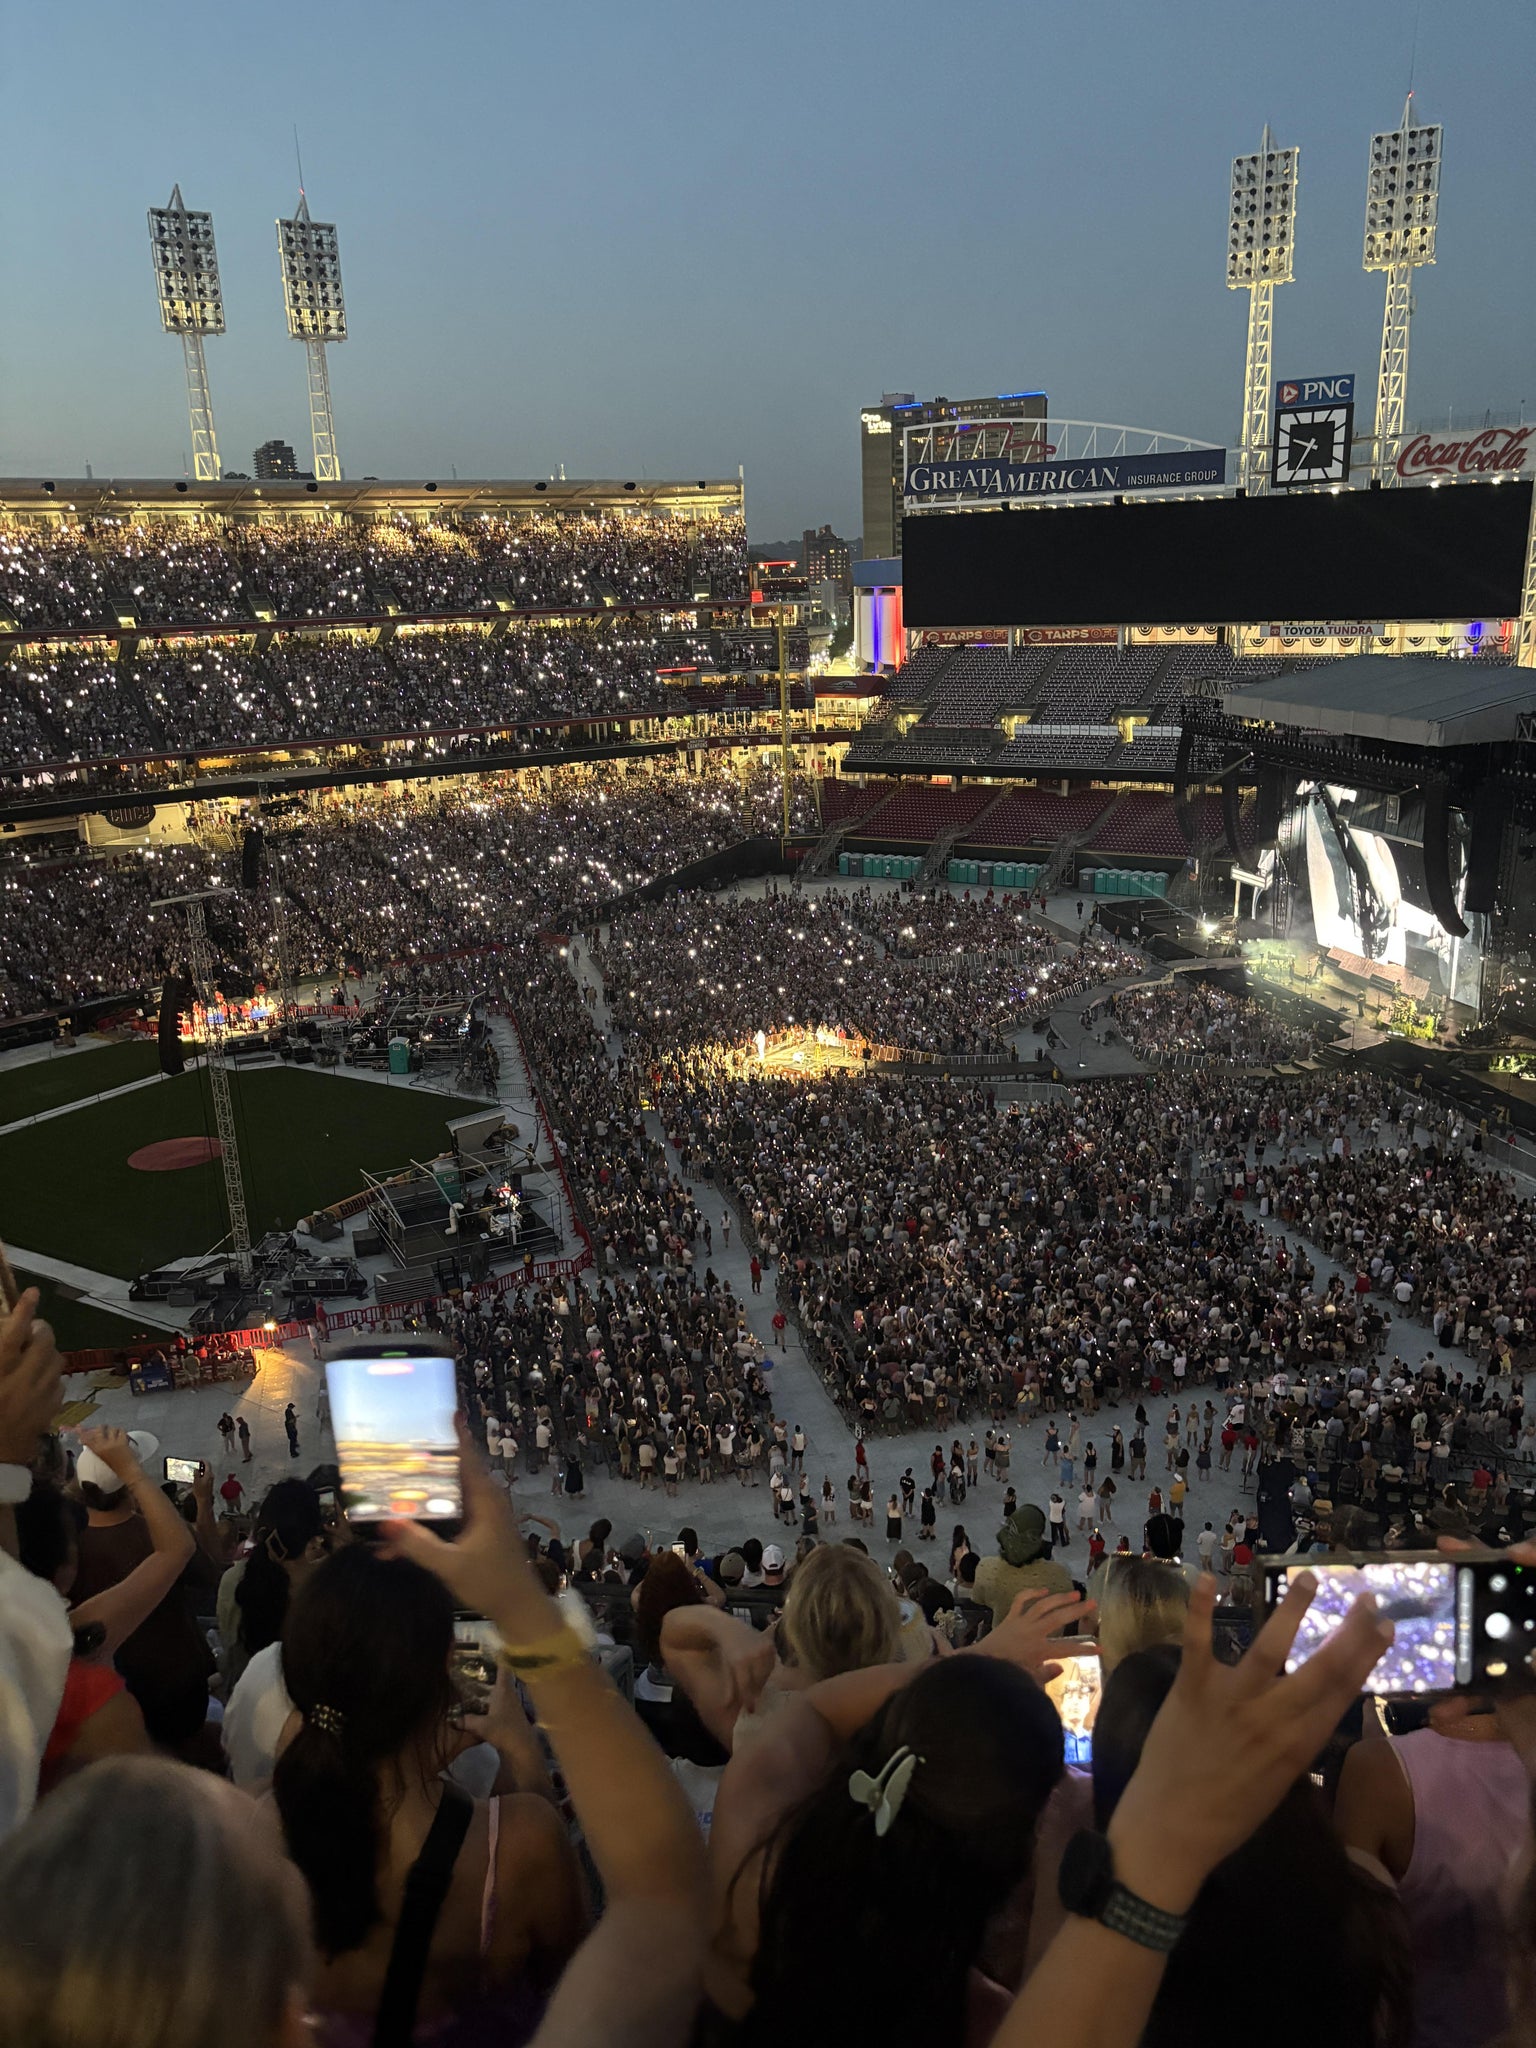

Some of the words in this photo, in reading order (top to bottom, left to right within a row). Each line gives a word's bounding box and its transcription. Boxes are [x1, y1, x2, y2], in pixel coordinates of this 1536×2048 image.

[1303, 379, 1350, 401] PNC
[1397, 427, 1536, 477] Coca-Cola
[910, 467, 993, 491] GREAT
[984, 466, 1120, 493] AMERICAN
[1127, 472, 1182, 486] INSURANCE
[1184, 470, 1217, 482] GROUP
[942, 630, 983, 641] TARPS
[1045, 629, 1089, 640] TARPS
[1090, 627, 1118, 639] OFF
[1284, 626, 1325, 636] TOYOTA
[1327, 625, 1373, 635] TUNDRA
